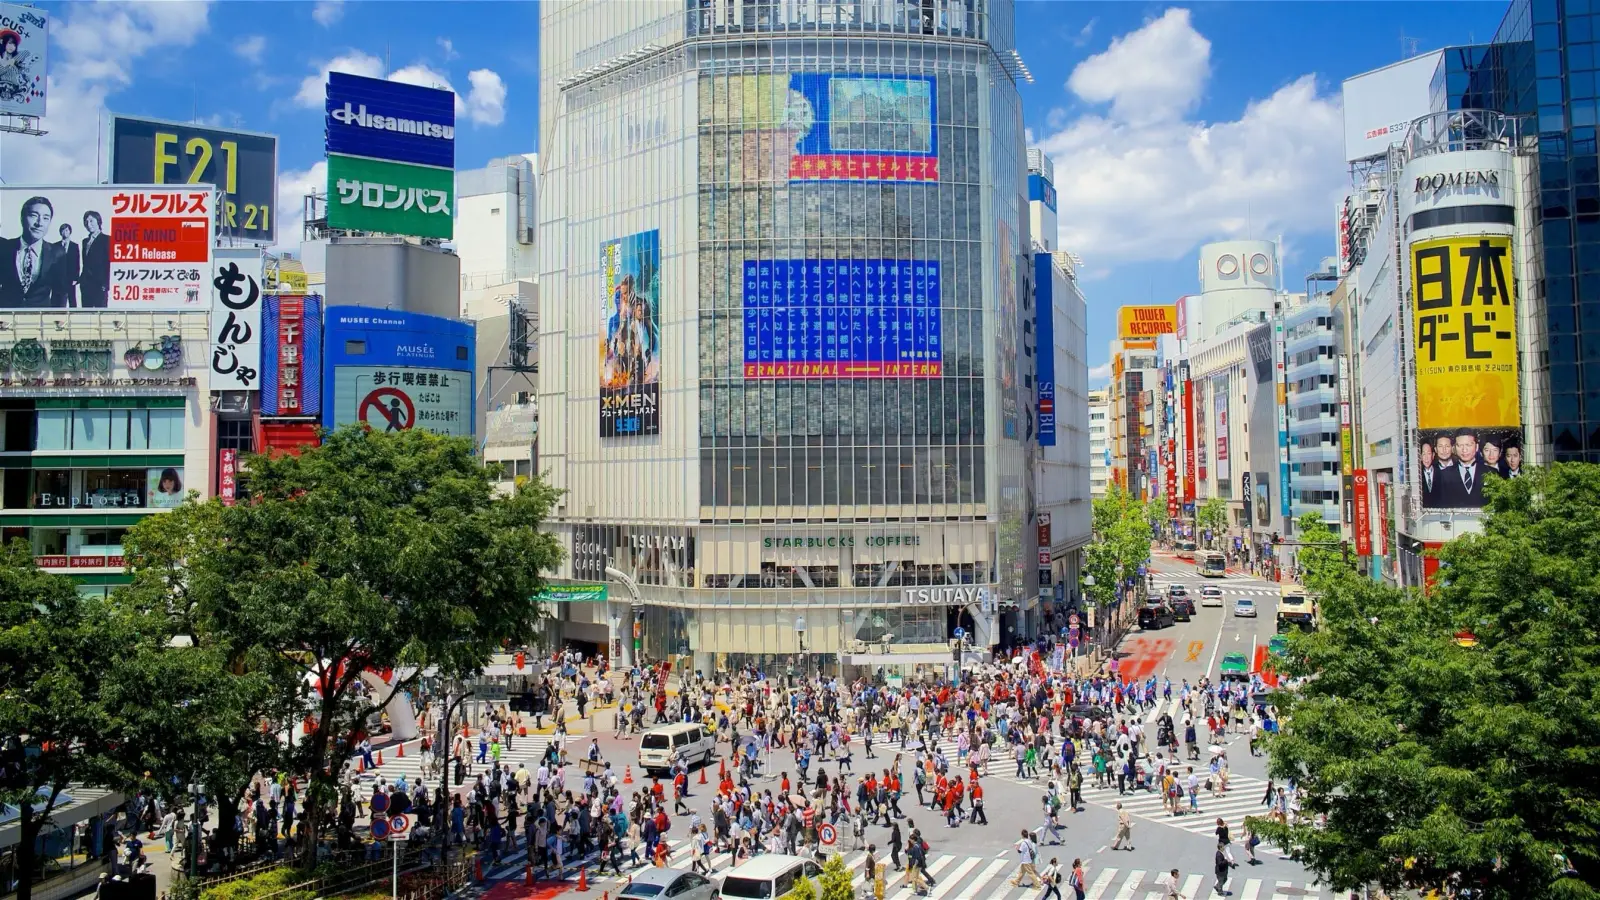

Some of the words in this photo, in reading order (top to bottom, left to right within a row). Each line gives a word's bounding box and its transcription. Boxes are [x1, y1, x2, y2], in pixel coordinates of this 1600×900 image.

[331, 102, 455, 140] Hisamitsu
[112, 192, 208, 214] ウルフルズ
[336, 178, 451, 216] サロンパス
[244, 205, 269, 231] 21
[114, 228, 140, 242] ONE
[143, 228, 176, 242] MIND
[113, 243, 140, 260] 5.21
[142, 247, 177, 260] Release
[1415, 240, 1511, 311] 日本
[113, 285, 140, 301] 5.20
[340, 316, 370, 325] MUSEE
[372, 317, 405, 326] Channel
[1132, 308, 1166, 321] TOWER
[212, 261, 260, 386] もんじゃ
[1129, 321, 1173, 335] RECORDS
[1418, 312, 1512, 362] ダービー
[373, 370, 450, 388] 歩行喫煙禁止
[418, 392, 441, 404] たばこは
[1039, 382, 1054, 434] SEIBU
[1243, 476, 1251, 502] ZARA
[41, 492, 141, 507] Euphoria
[575, 542, 601, 554] BOOK
[631, 534, 685, 550] TSUTAYA
[763, 536, 856, 548] STARBUCKS
[865, 535, 920, 547] COFFEE
[575, 558, 601, 571] CAFE
[905, 586, 985, 605] TSUTAYA
